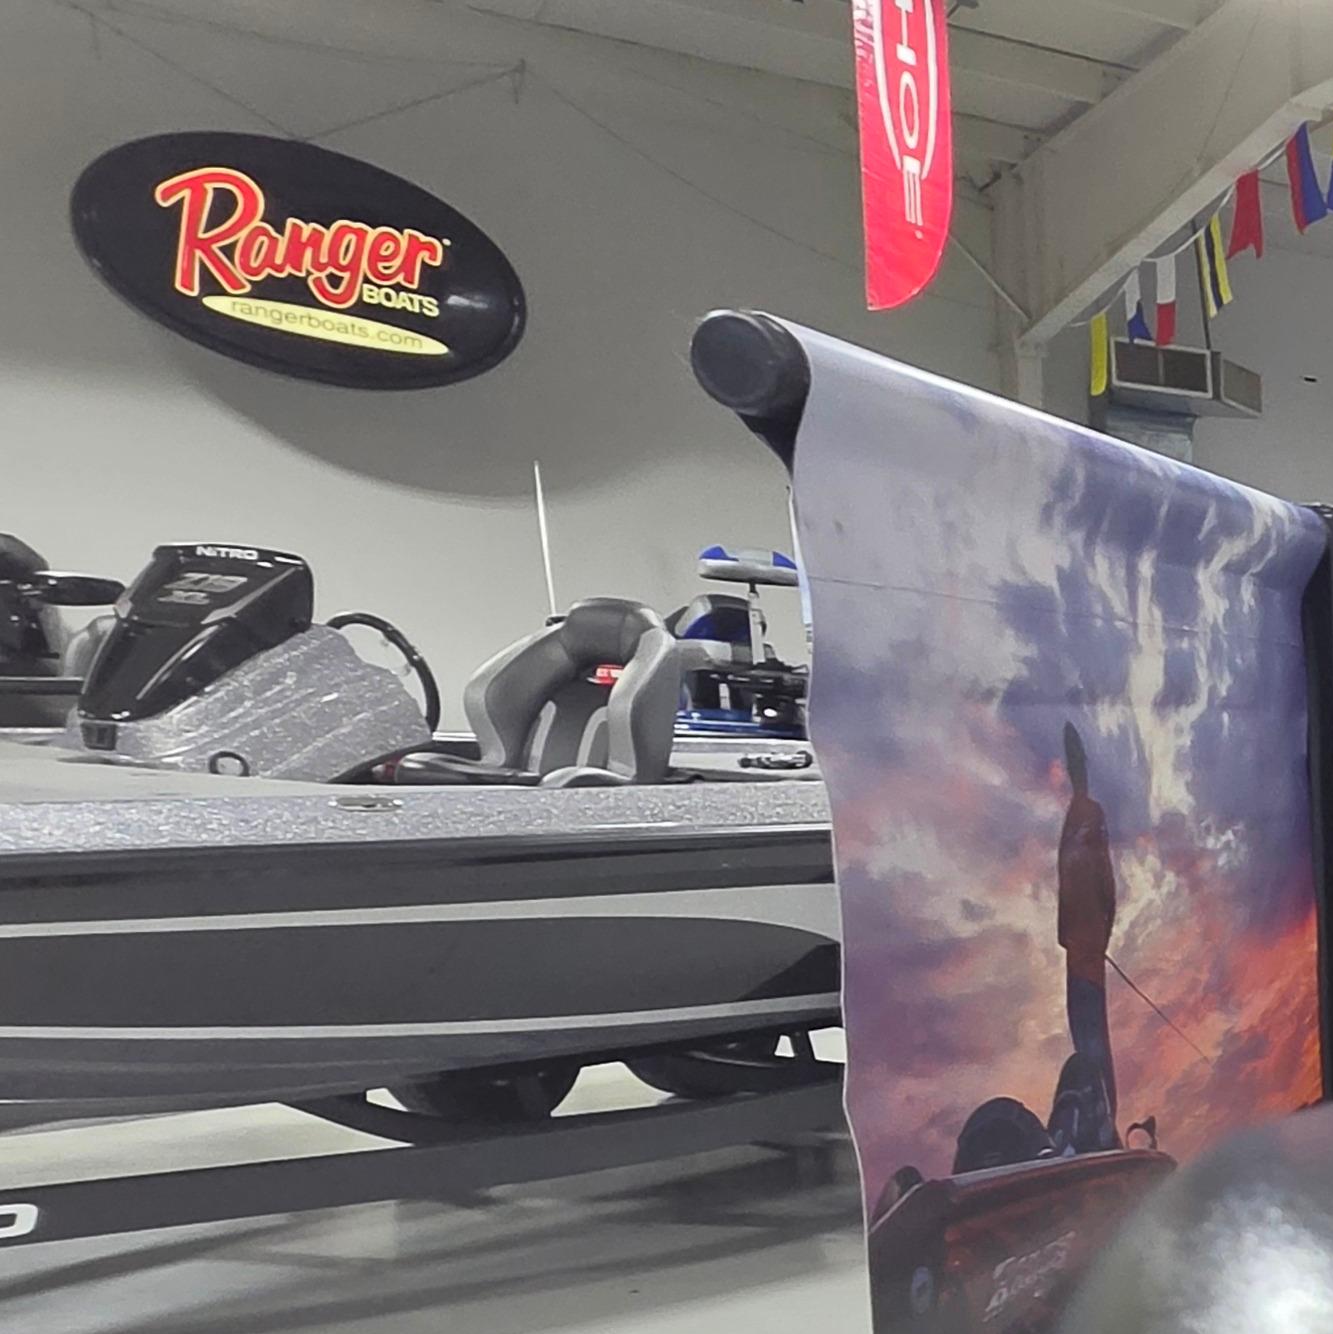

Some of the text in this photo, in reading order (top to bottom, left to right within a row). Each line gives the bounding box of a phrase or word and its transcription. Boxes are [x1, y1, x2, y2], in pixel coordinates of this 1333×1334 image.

[155, 167, 444, 309] Ranger
[362, 285, 440, 317] BOATS
[230, 301, 423, 349] rangerboats.com
[196, 546, 259, 560] NITRO
